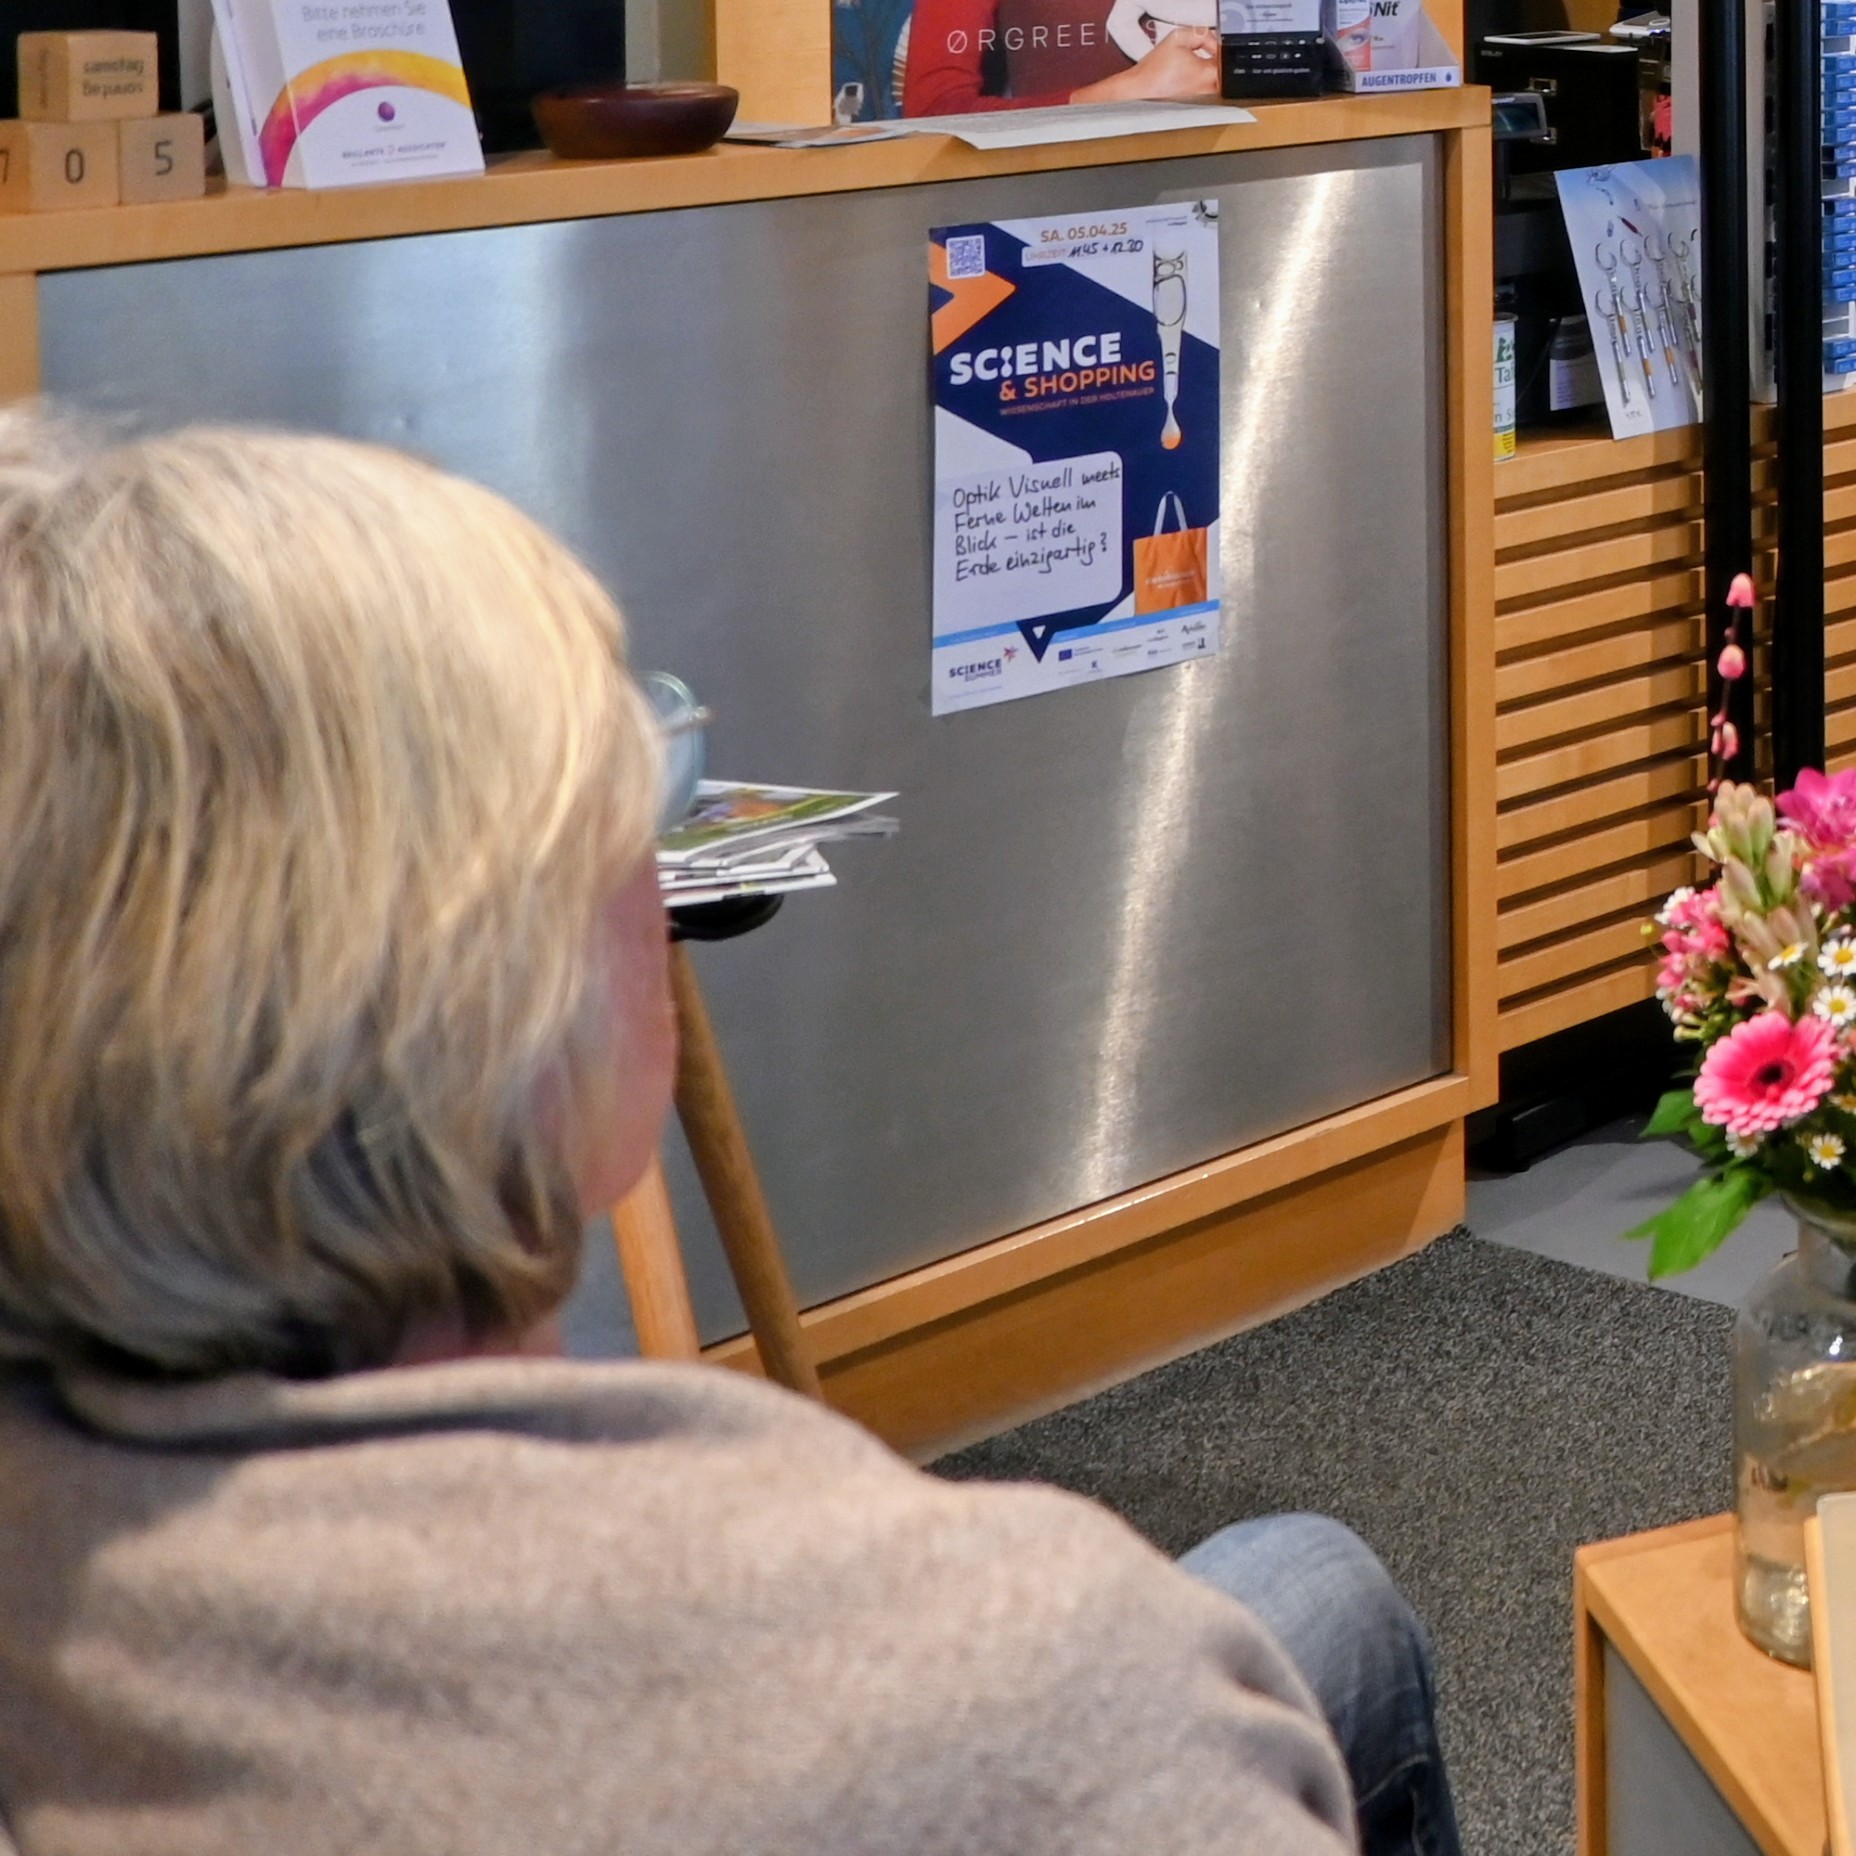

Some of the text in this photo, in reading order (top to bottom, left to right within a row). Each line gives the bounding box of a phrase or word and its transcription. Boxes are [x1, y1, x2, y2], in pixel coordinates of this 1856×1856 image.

[302, 0, 426, 22] Bitte nehmen Sie
[317, 22, 426, 42] eine Broschüre
[1361, 72, 1436, 87] AUGENTROPFEN
[64, 139, 173, 185] 0 5
[1040, 229, 1065, 244] SA.
[1067, 222, 1128, 241] 05.04.25
[949, 331, 1122, 386] SCIENCE
[998, 360, 1156, 402] & SHOPPING
[953, 461, 1121, 515] Optik Visuell meets
[955, 495, 1097, 533] Ferne Welten im
[955, 519, 1077, 556] Blick ist die
[955, 553, 1001, 582] Erde
[949, 658, 1002, 679] SCIENCE
